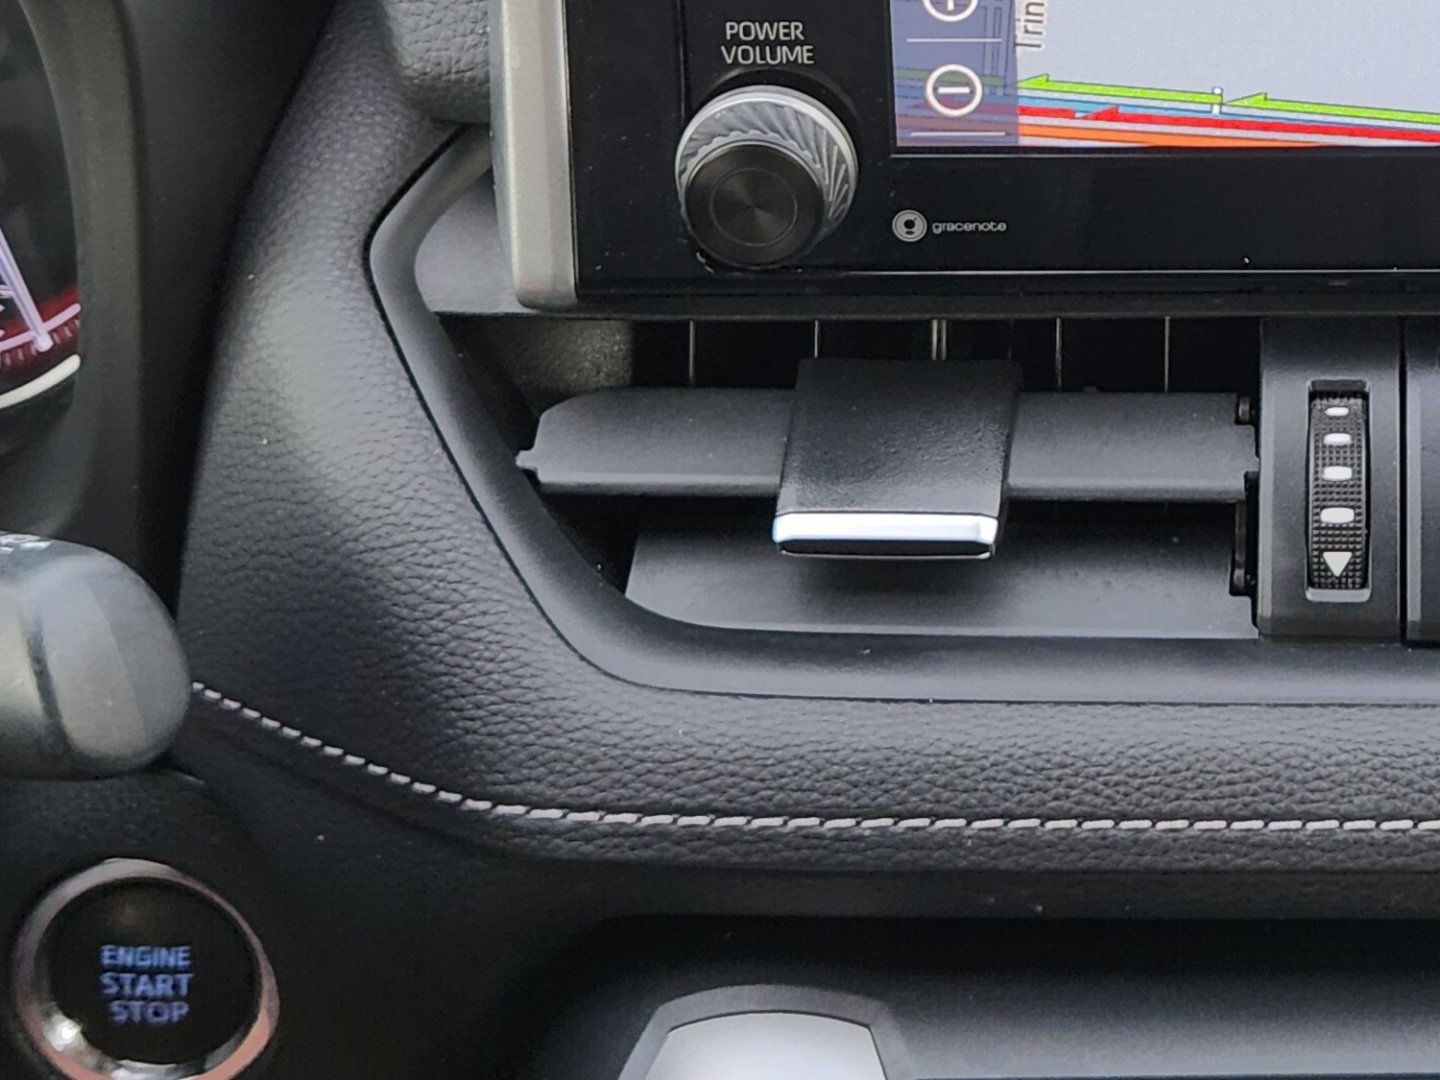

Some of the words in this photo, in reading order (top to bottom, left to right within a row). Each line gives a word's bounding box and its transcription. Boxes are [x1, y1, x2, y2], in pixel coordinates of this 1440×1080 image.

[725, 22, 804, 42] POWER
[721, 44, 815, 65] VOLUME
[932, 221, 1007, 235] gracenote
[101, 944, 192, 968] ENGINE
[101, 971, 194, 997] START
[109, 999, 190, 1023] STOP
